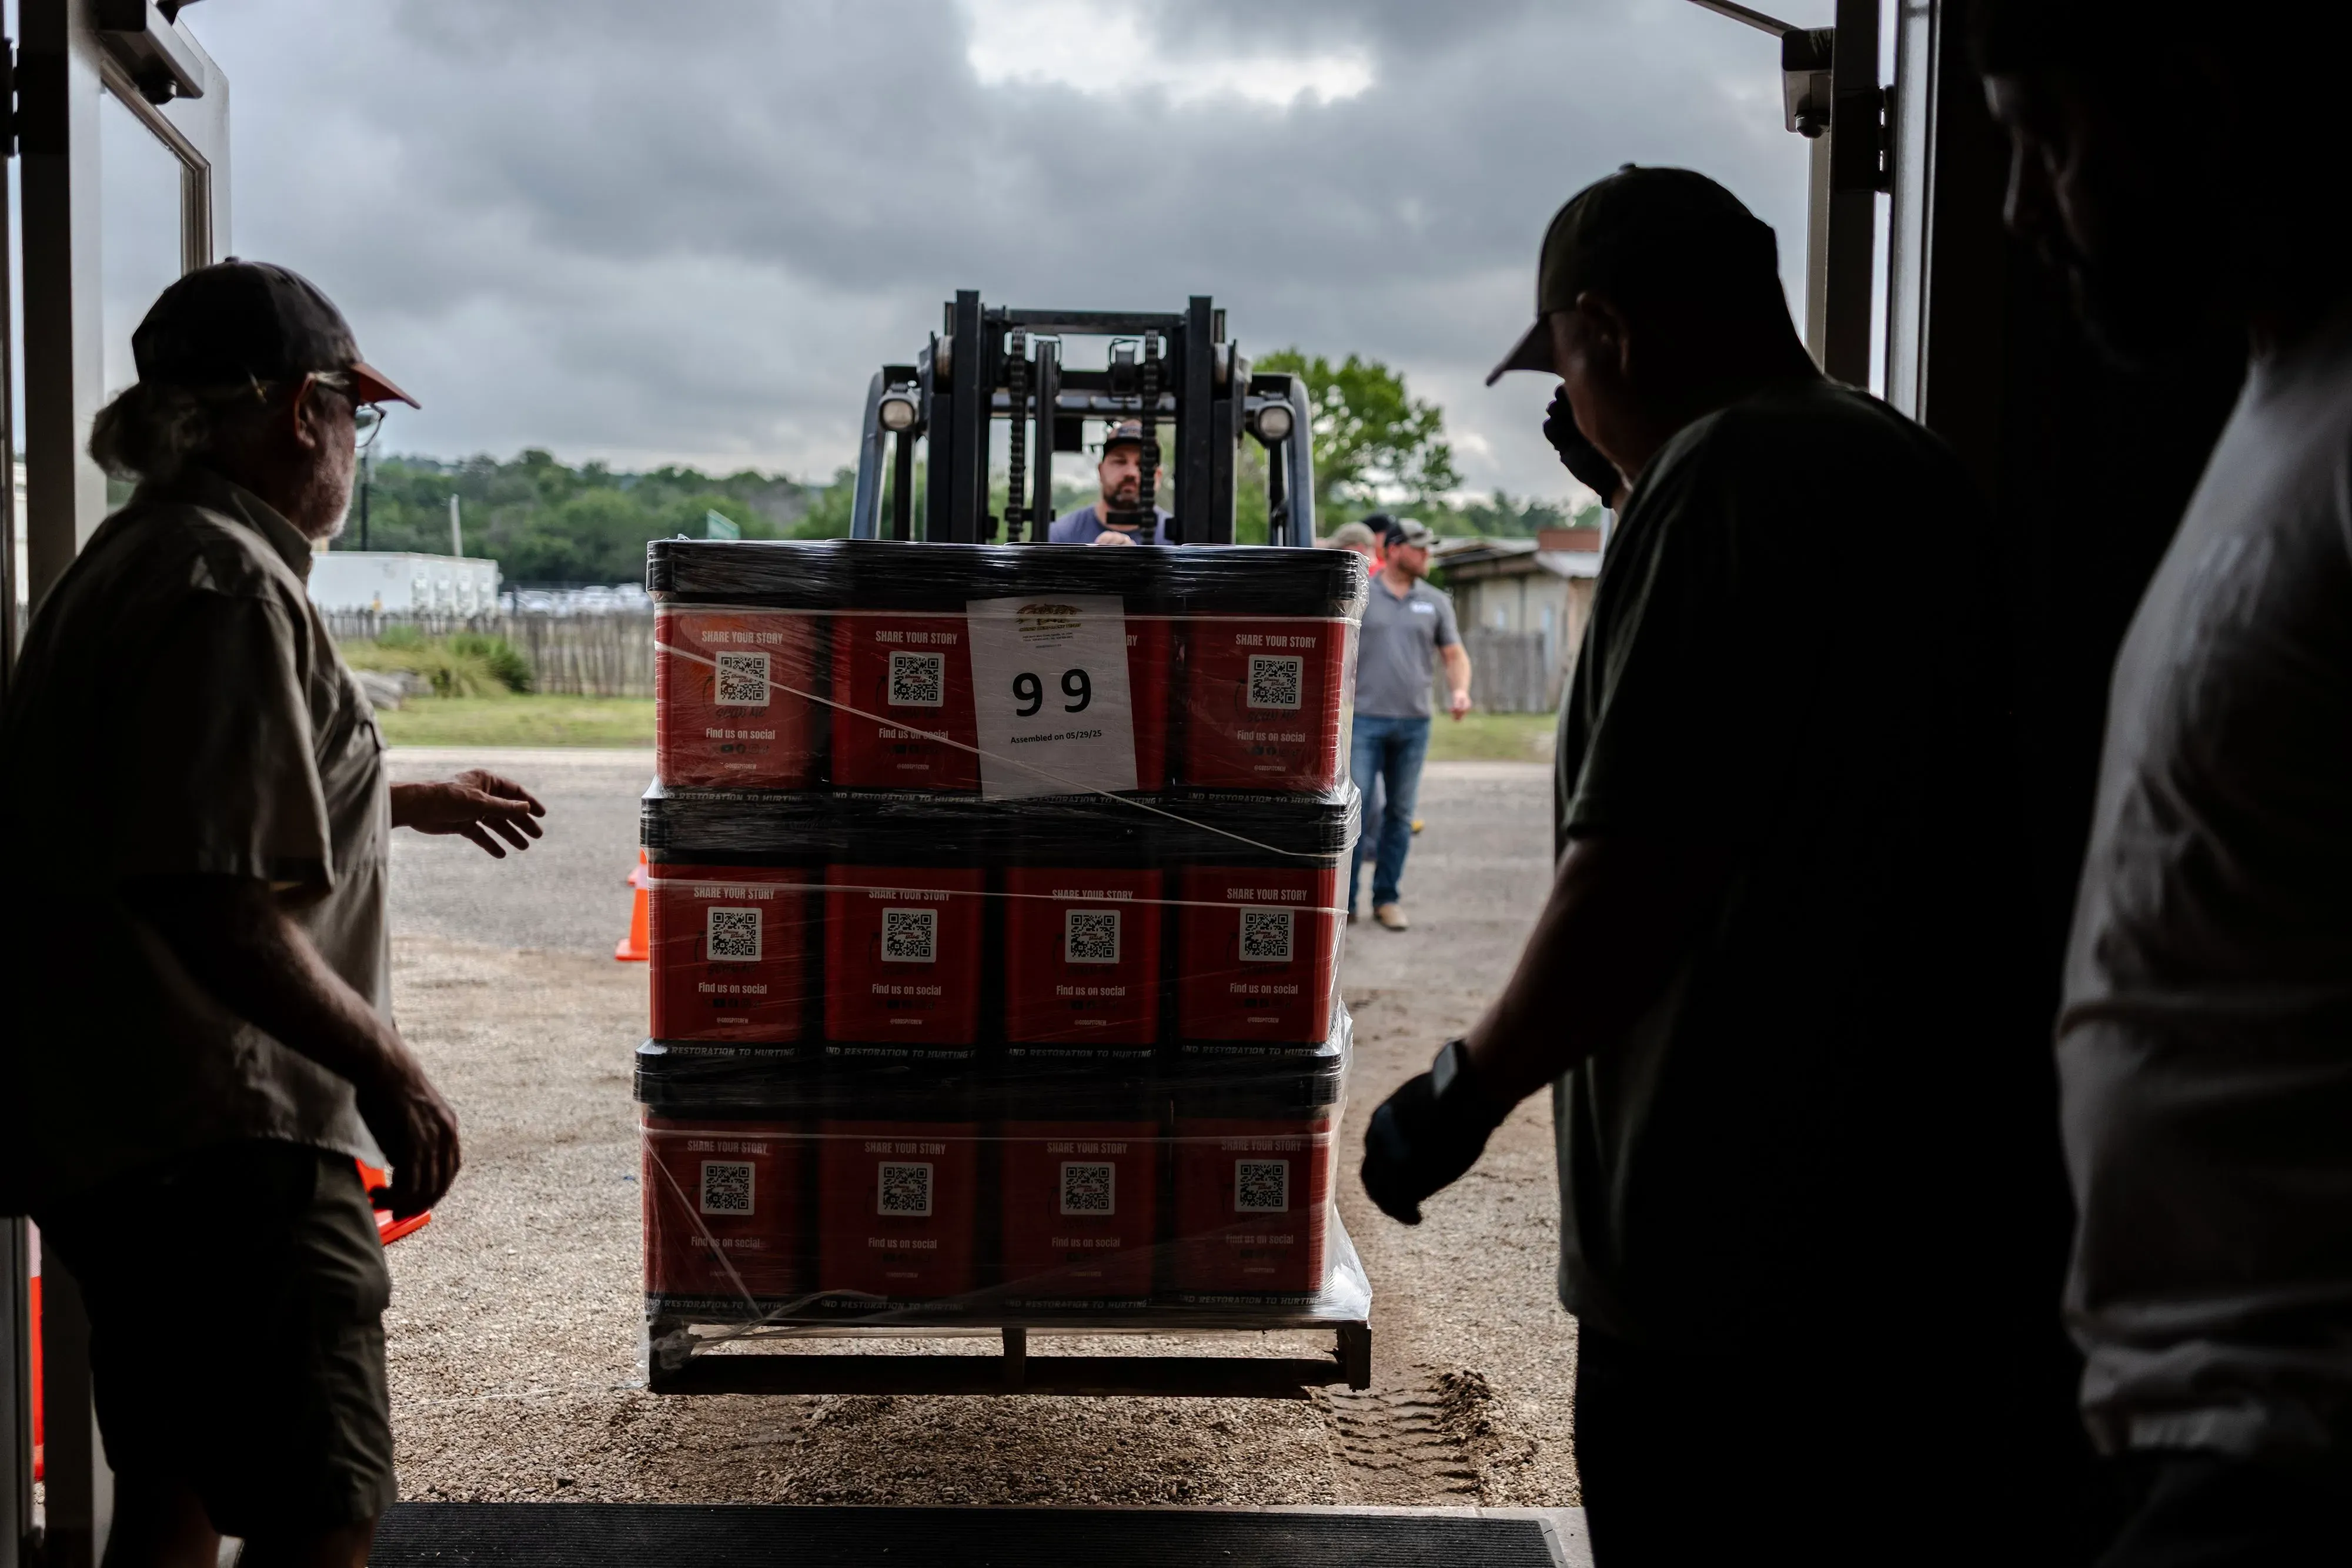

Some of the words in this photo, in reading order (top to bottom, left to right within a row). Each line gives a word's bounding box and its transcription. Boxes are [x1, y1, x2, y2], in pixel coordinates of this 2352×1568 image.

[701, 631, 729, 642] SHARE
[732, 631, 754, 643] YOUR
[756, 633, 783, 644] STORY
[876, 630, 903, 642] SHARE
[906, 631, 928, 643] YOUR
[930, 633, 957, 644] STORY
[1235, 634, 1263, 646] SHARE
[1265, 635, 1287, 647] YOUR
[1289, 636, 1316, 648] STORY
[1013, 673, 1043, 717] 9
[1061, 668, 1091, 713] 9
[706, 727, 723, 738] Find
[725, 729, 735, 738] us
[737, 730, 748, 739] on
[750, 729, 775, 740] social
[879, 728, 896, 738] Find
[898, 729, 908, 739] us
[1010, 734, 1052, 744] Assembled
[1065, 730, 1102, 740] 05/29/25
[1237, 730, 1254, 740] Find
[1256, 731, 1266, 741] us
[1268, 732, 1278, 741] on
[1281, 731, 1305, 743] social
[679, 793, 743, 801] RESTORATION
[851, 792, 915, 801] RESTORATION
[1208, 794, 1271, 803] RESTORATION
[694, 887, 721, 898] SHARE
[724, 887, 746, 899] YOUR
[748, 888, 774, 900] STORY
[868, 888, 896, 900] SHARE
[900, 890, 921, 900] YOUR
[923, 890, 950, 901] STORY
[1052, 890, 1080, 900] SHARE
[1082, 890, 1104, 900] YOUR
[1106, 891, 1133, 900] STORY
[1227, 888, 1254, 900] SHARE
[1257, 888, 1278, 900] YOUR
[1281, 889, 1307, 901] STORY
[699, 982, 715, 992] Find
[717, 984, 727, 993] us
[730, 984, 740, 994] on
[742, 984, 767, 994] social
[872, 983, 889, 994] Find
[891, 985, 901, 995] us
[904, 986, 914, 995] on
[916, 985, 941, 995] social
[1056, 985, 1073, 995] Find
[1075, 987, 1085, 995] us
[1088, 987, 1098, 996] on
[1100, 986, 1125, 997] social
[1230, 982, 1247, 993] Find
[1249, 984, 1259, 993] us
[1261, 985, 1271, 994] on
[1274, 984, 1298, 994] social
[671, 1047, 735, 1056] RESTORATION
[754, 1048, 795, 1057] HURTING
[844, 1047, 908, 1057] RESTORATION
[912, 1049, 924, 1058] TO
[927, 1050, 968, 1059] HURTING
[1008, 1048, 1025, 1056] AND
[1030, 1049, 1093, 1058] RESTORATION
[1112, 1050, 1151, 1058] HURTING
[1202, 1046, 1265, 1055] RESTORATION
[687, 1141, 714, 1152] SHARE
[717, 1141, 739, 1152] YOUR
[741, 1142, 768, 1154] STORY
[864, 1141, 892, 1153] SHARE
[895, 1142, 917, 1154] YOUR
[919, 1143, 946, 1155] STORY
[1047, 1142, 1074, 1153] SHARE
[1077, 1142, 1098, 1154] YOUR
[1101, 1143, 1128, 1154] STORY
[1221, 1140, 1249, 1151] SHARE
[1252, 1141, 1273, 1151] YOUR
[1275, 1141, 1301, 1152] STORY
[691, 1236, 708, 1246] Find
[722, 1238, 733, 1247] on
[734, 1238, 760, 1248] social
[868, 1237, 886, 1248] Find
[887, 1239, 898, 1248] us
[900, 1239, 910, 1248] on
[912, 1238, 937, 1249] social
[1051, 1236, 1069, 1247] Find
[1071, 1239, 1081, 1248] us
[1083, 1239, 1093, 1248] on
[1095, 1238, 1120, 1248] social
[1226, 1233, 1242, 1244] Find
[1244, 1235, 1255, 1244] us
[1257, 1235, 1267, 1244] on
[1269, 1234, 1294, 1245] social
[663, 1299, 727, 1309] RESTORATION
[841, 1301, 904, 1310] RESTORATION
[1108, 1300, 1147, 1308] HURTING
[1199, 1296, 1261, 1304] RESTORATION
